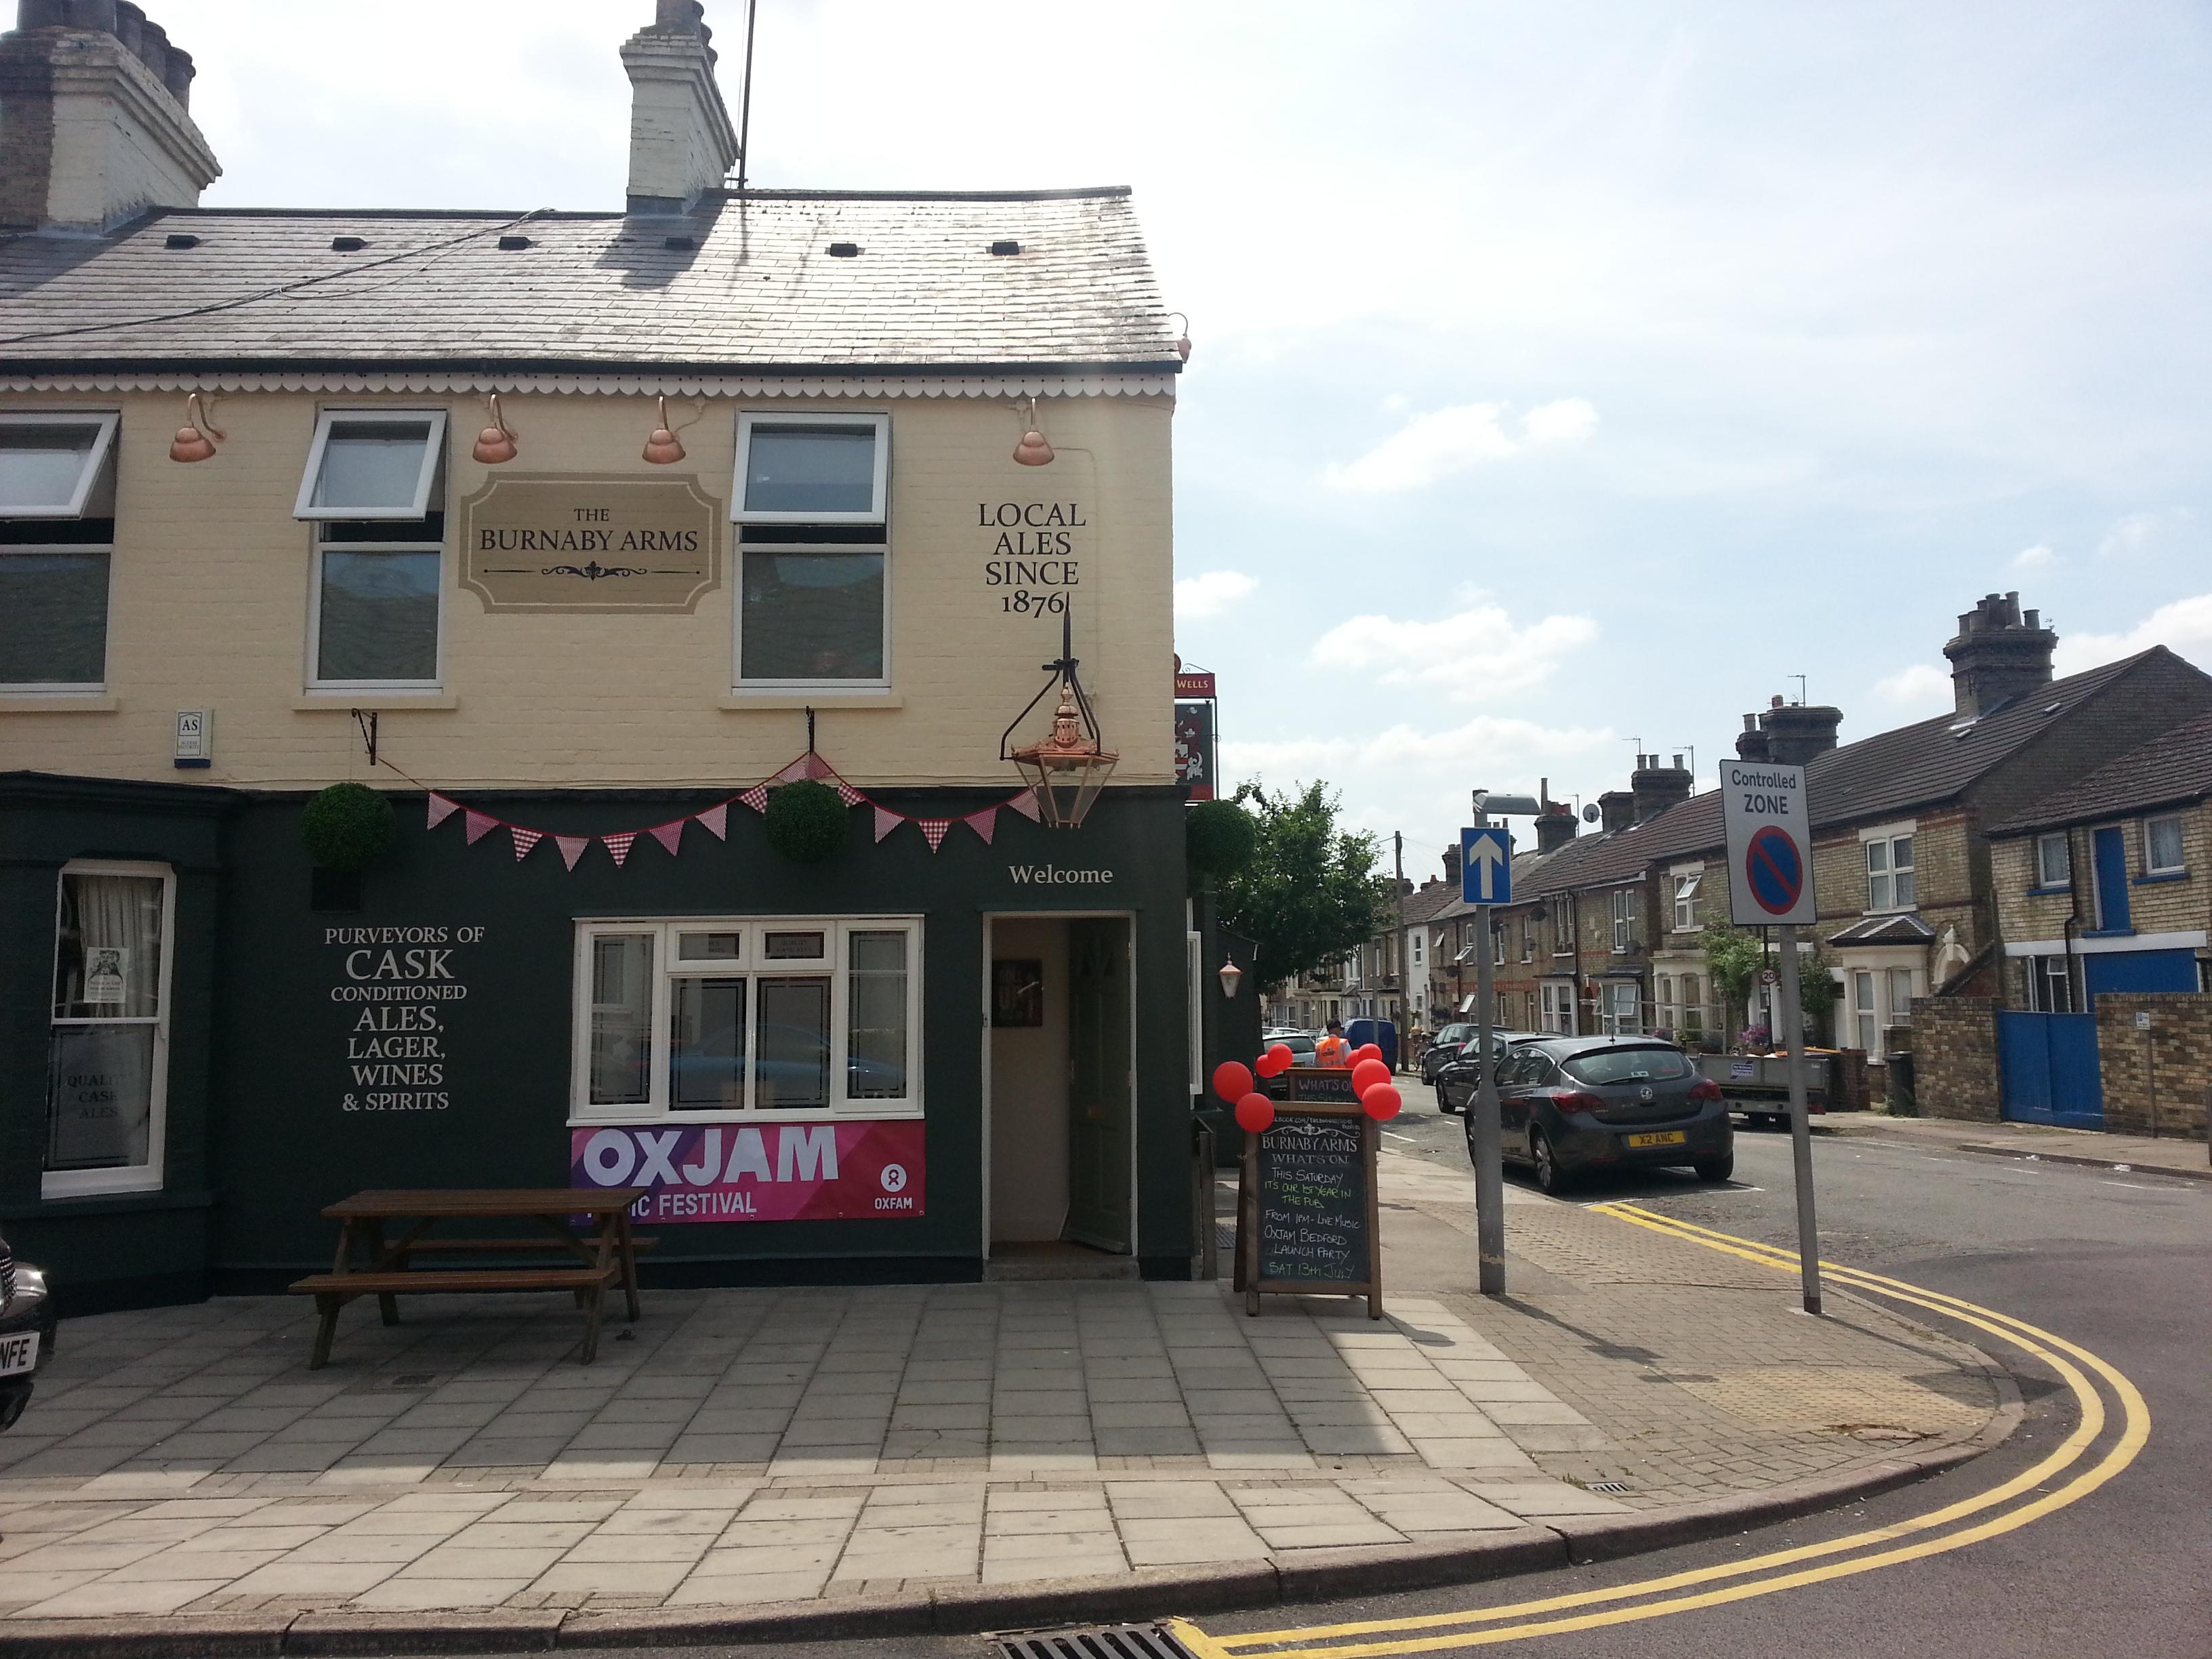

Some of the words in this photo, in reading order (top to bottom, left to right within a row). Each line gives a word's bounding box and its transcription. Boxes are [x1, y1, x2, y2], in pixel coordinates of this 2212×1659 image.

[573, 508, 610, 521] THE
[978, 503, 1086, 527] LOCAL
[480, 529, 614, 552] BURNABY
[619, 530, 698, 552] ARMS
[993, 532, 1071, 555] ALES
[985, 561, 1079, 586] SINCE
[1002, 590, 1065, 618] 1876
[1176, 680, 1208, 689] WELLS
[182, 719, 198, 731] AS
[1732, 769, 1797, 790] Controlled
[1744, 794, 1789, 815] ZONE
[1008, 864, 1114, 884] Welcome
[325, 927, 448, 944] PURVEYORS
[457, 926, 485, 943] OF
[346, 949, 455, 979] CASK
[331, 985, 468, 1002] CONDITIONED
[353, 1006, 444, 1033] ALES,
[347, 1036, 446, 1060] LAGER,
[351, 1063, 443, 1086] WINES
[342, 1092, 361, 1111] &
[365, 1092, 449, 1111] SPIRITS
[1263, 1136, 1319, 1151] BURNABY
[1322, 1138, 1357, 1152] ARMS
[1639, 1134, 1652, 1145] X2
[1656, 1132, 1675, 1143] ANC
[583, 1125, 839, 1187] OXJAM
[1329, 1154, 1350, 1164] ON
[1271, 1166, 1293, 1181] THIS
[1296, 1169, 1344, 1187] SATURDAY
[1282, 1183, 1300, 1193] OUR
[1315, 1185, 1338, 1197] YEAR
[1341, 1189, 1351, 1199] IN
[1282, 1195, 1301, 1205] THE
[659, 1192, 757, 1216] FESTIVAL
[874, 1197, 913, 1210] OXFAM
[1265, 1209, 1290, 1223] FROM
[1317, 1214, 1334, 1226] LIVE
[1335, 1214, 1361, 1229] MUSIC
[1265, 1225, 1296, 1245] OXJAM
[1300, 1228, 1347, 1246] BEDFORD
[1274, 1244, 1314, 1258] LAUNCH
[1317, 1247, 1351, 1265] PARTY
[1269, 1262, 1293, 1275] SAT
